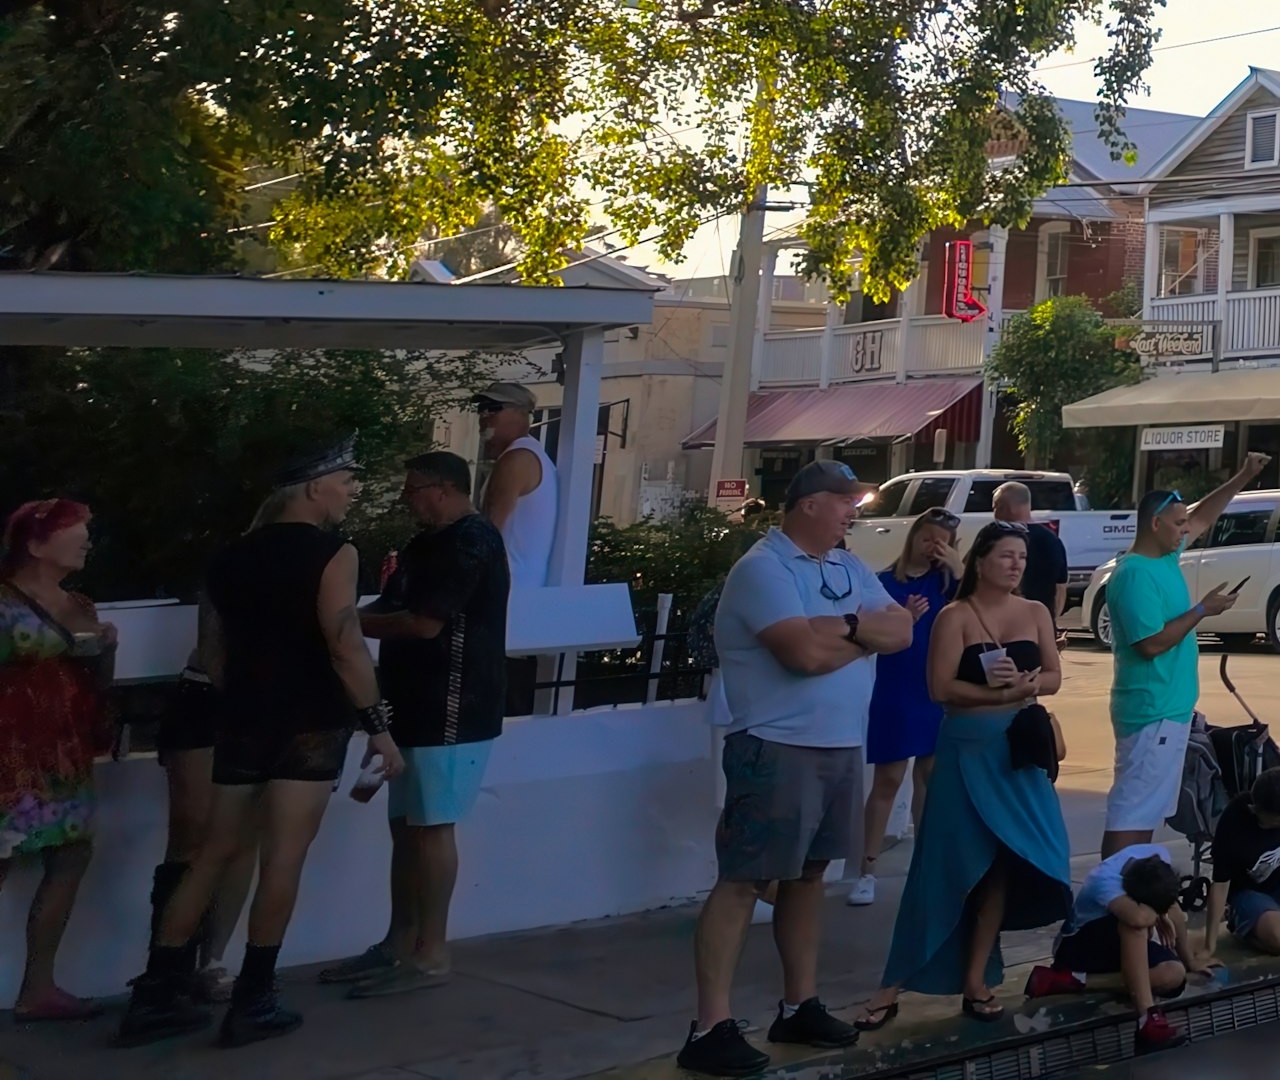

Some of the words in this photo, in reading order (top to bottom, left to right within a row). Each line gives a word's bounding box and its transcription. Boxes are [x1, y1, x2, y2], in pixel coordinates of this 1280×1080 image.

[1144, 431, 1183, 445] LIQUOR
[1186, 430, 1221, 443] STORE
[1103, 525, 1136, 533] GMC
